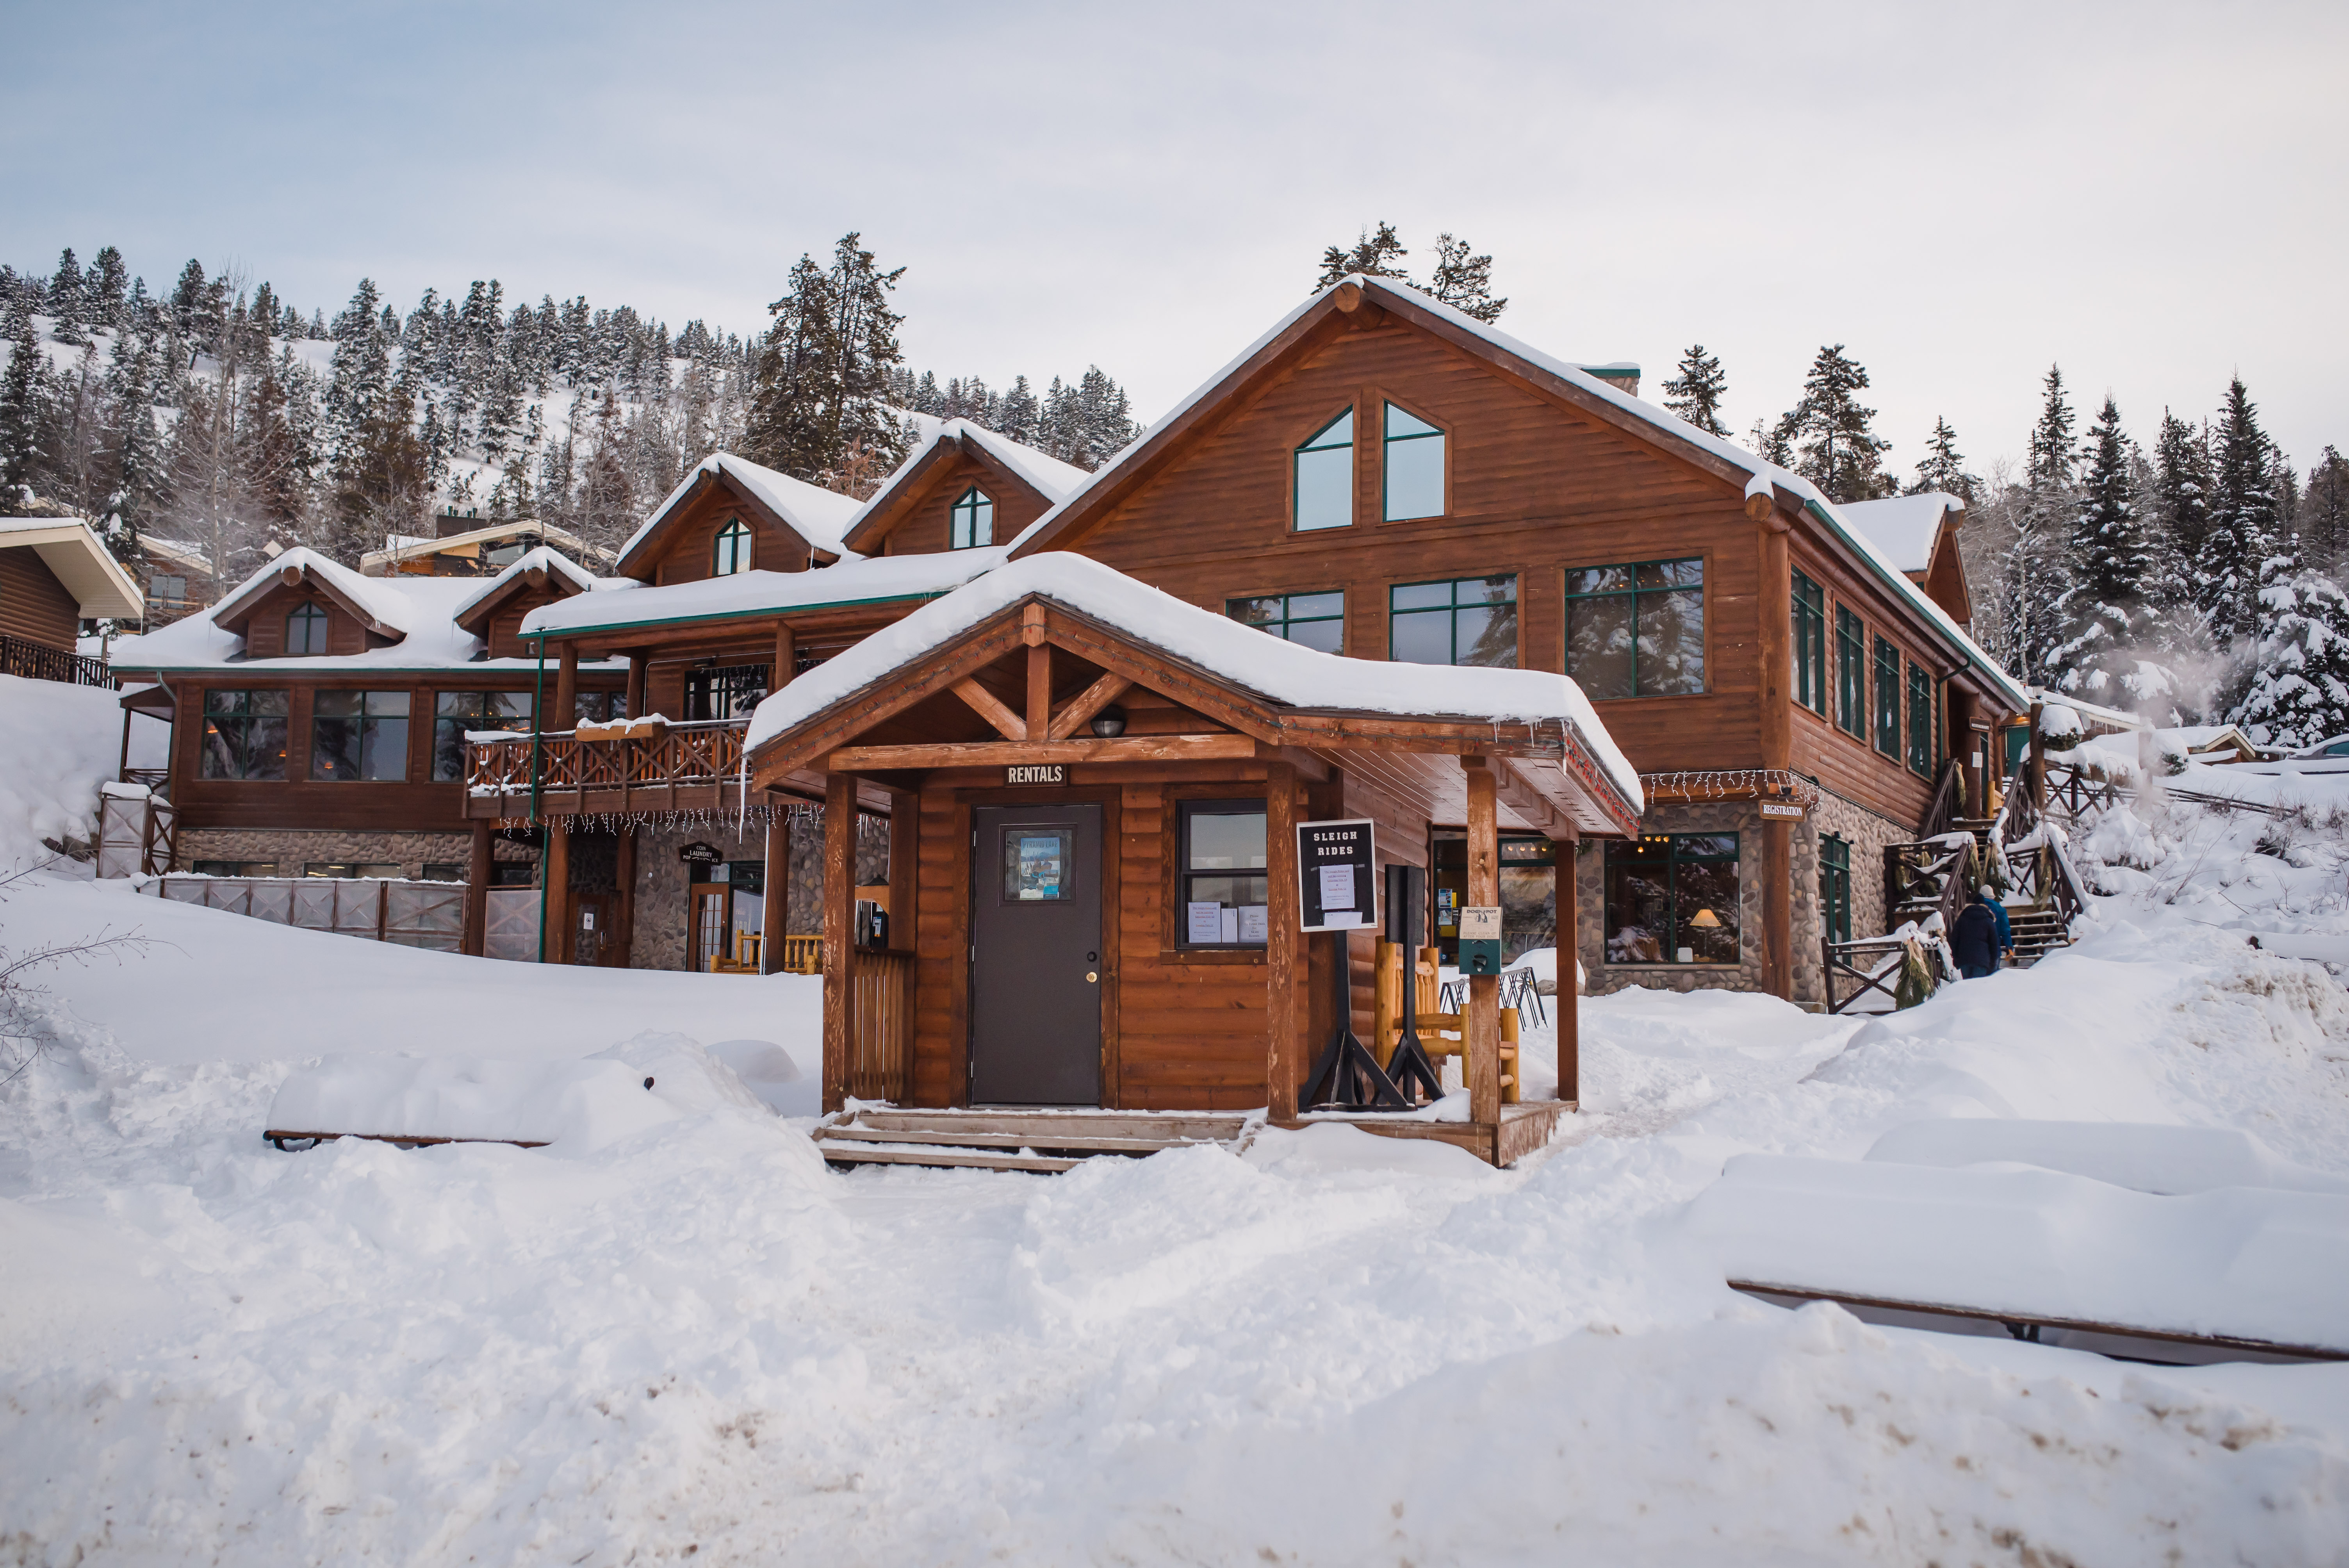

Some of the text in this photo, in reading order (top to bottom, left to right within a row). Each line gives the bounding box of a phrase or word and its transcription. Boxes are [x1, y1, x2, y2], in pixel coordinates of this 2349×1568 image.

[1009, 766, 1062, 783] RENTALS
[1763, 804, 1802, 816] REGISTRATION
[1314, 831, 1357, 841] SLEIGH
[1318, 846, 1353, 855] RIDES
